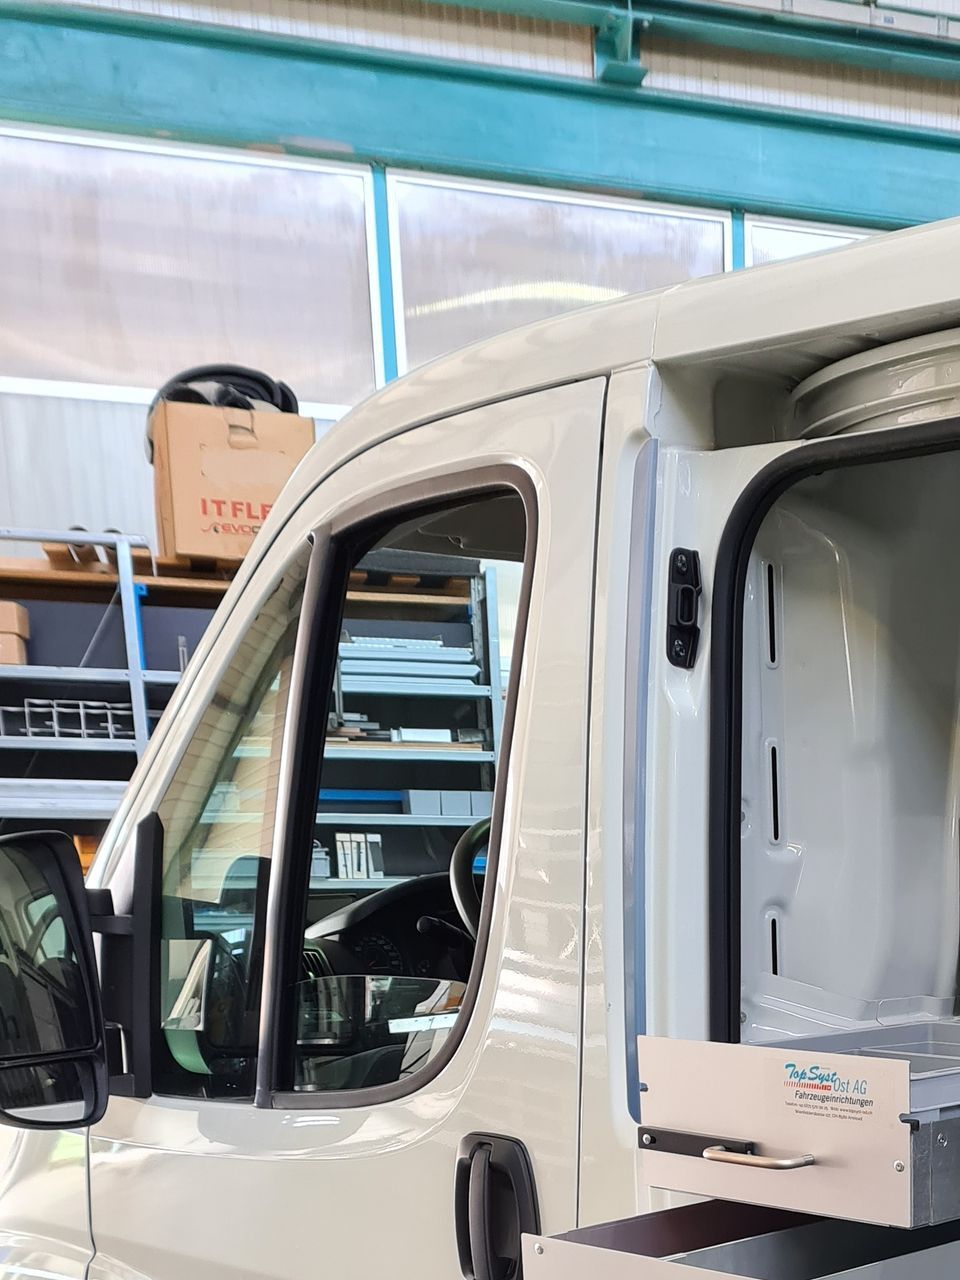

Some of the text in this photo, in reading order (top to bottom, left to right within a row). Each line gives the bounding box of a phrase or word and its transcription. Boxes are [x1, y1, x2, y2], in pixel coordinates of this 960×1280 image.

[833, 1077, 850, 1093] Ost
[852, 1079, 868, 1095] AG
[794, 1090, 873, 1107] Fahrzeugeinrichtungen
